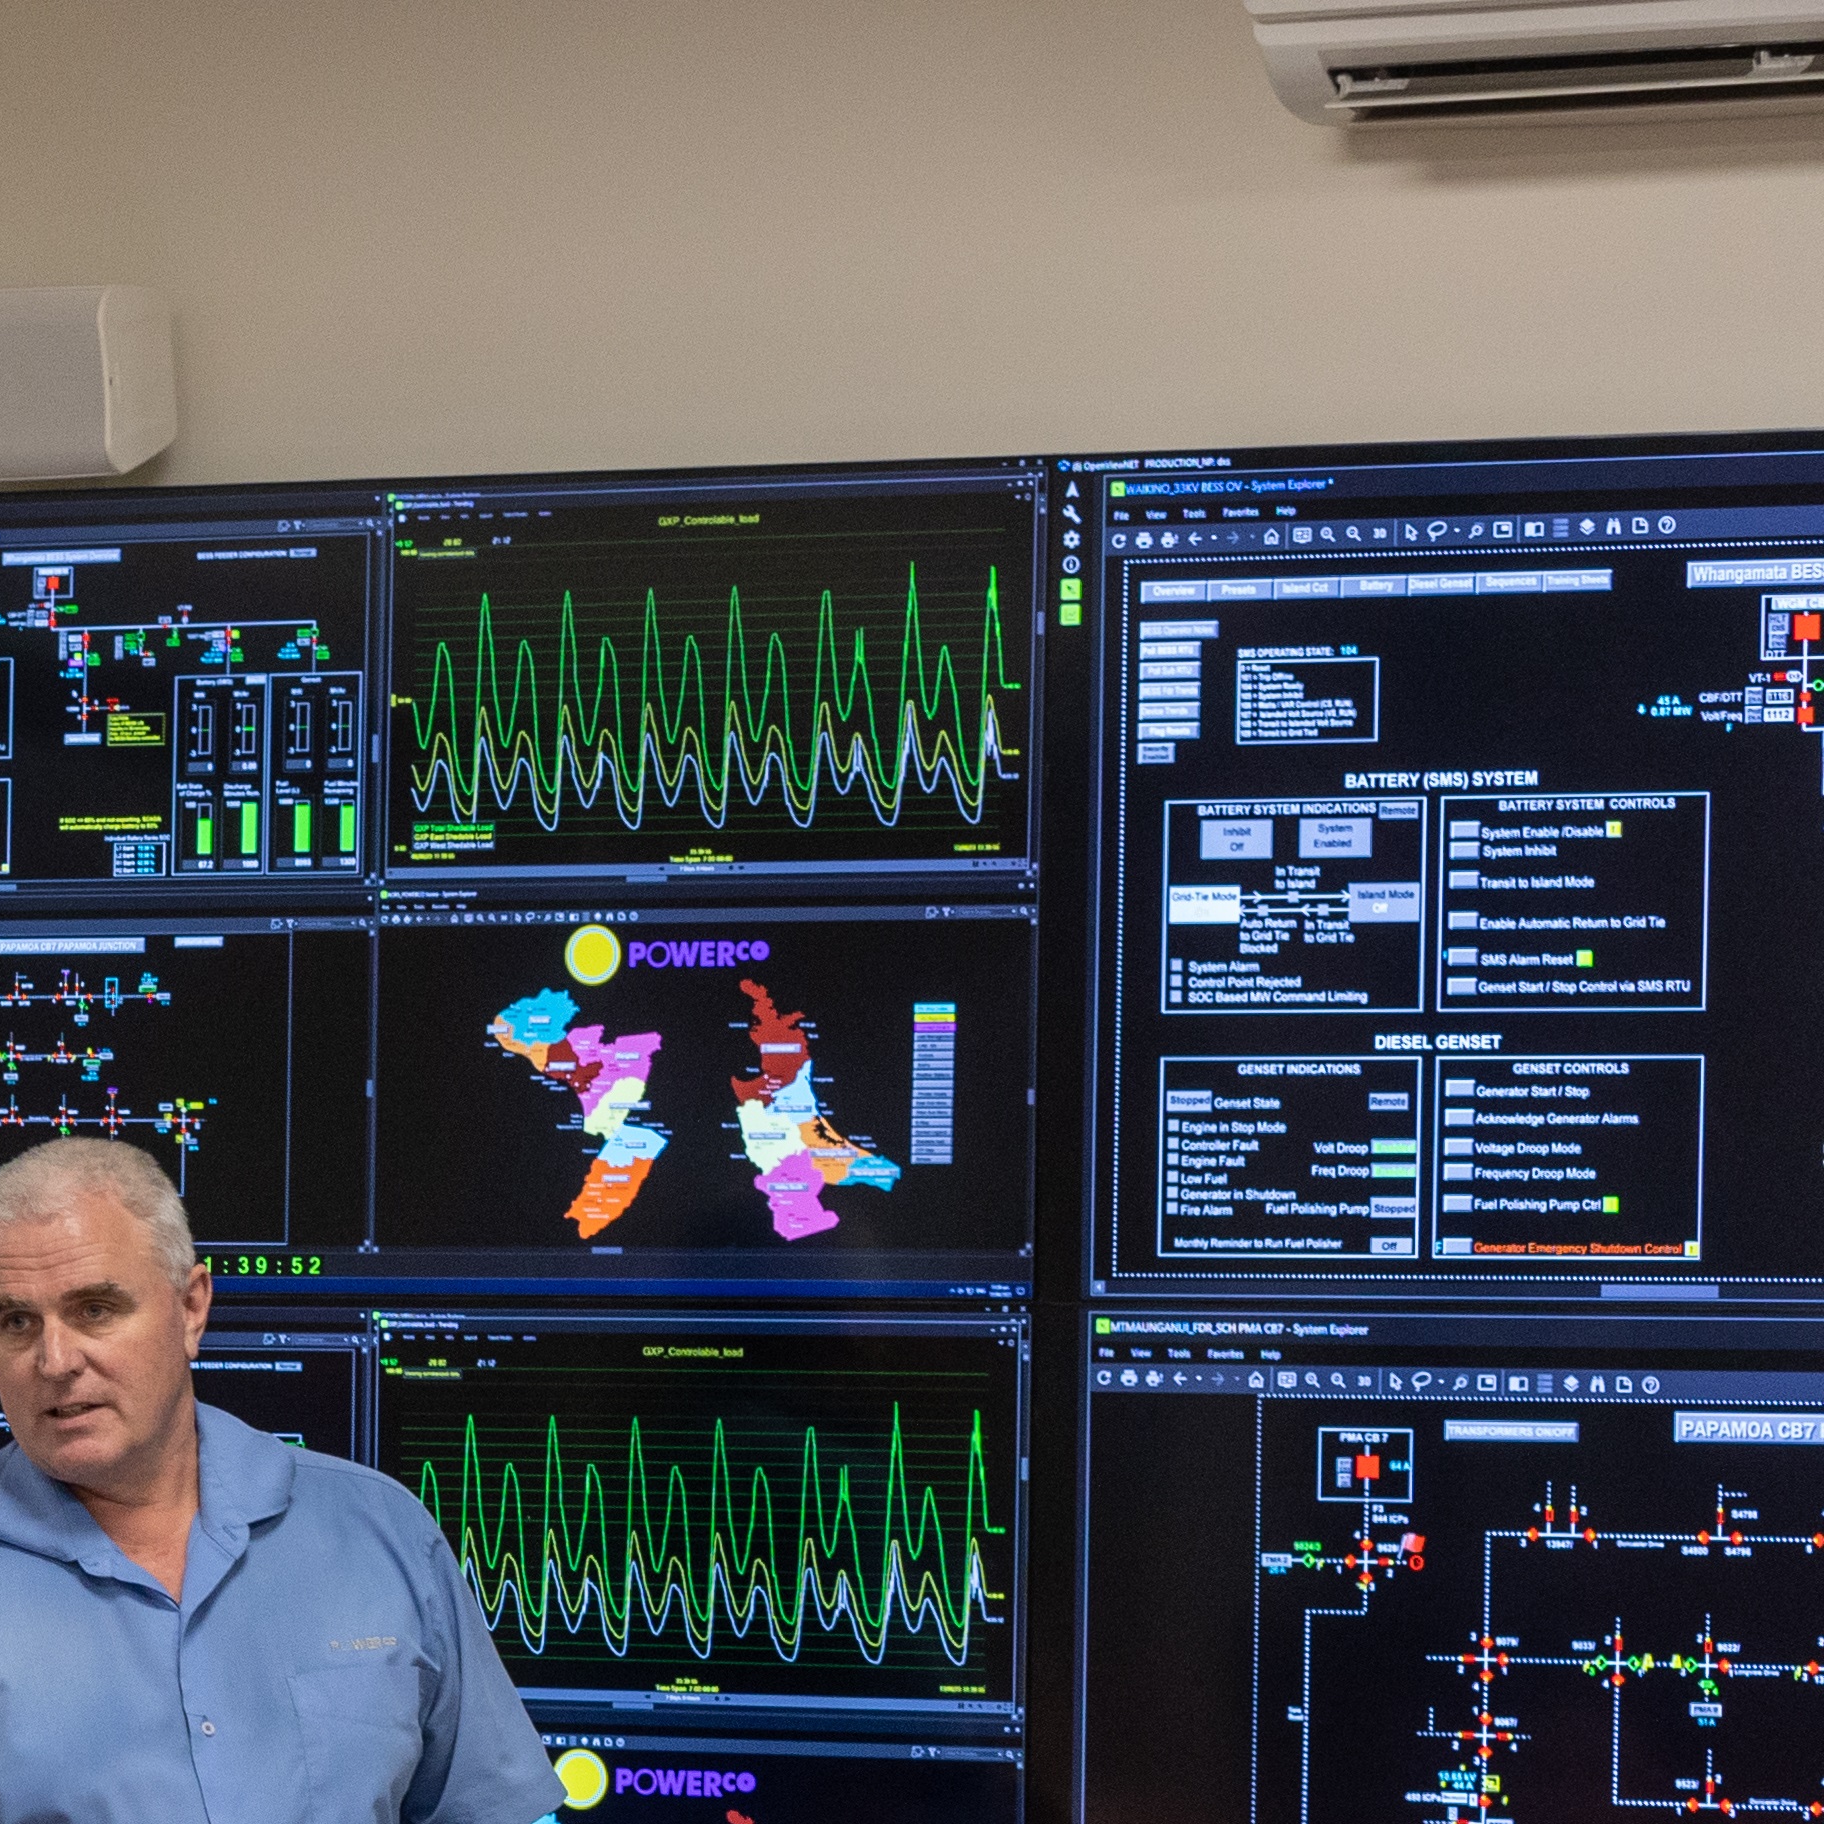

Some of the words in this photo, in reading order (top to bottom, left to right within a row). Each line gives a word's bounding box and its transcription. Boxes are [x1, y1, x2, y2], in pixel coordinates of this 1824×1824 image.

[1251, 480, 1285, 493] System
[1288, 479, 1326, 491] Explorer
[240, 550, 287, 559] CONFIGURATION
[1548, 575, 1580, 587] Training
[1581, 574, 1609, 585] Sheets
[1693, 566, 1787, 584] Whangamata
[1282, 582, 1308, 594] Island
[1360, 580, 1393, 593] Battery
[1409, 578, 1438, 589] Diesel
[1440, 577, 1473, 589] Genset
[1485, 576, 1537, 588] Sequences
[1153, 585, 1195, 597] Overview
[1222, 584, 1256, 595] Presets
[1344, 773, 1420, 789] BATTERY
[1423, 772, 1469, 789] (SMS)
[1472, 771, 1539, 786] SYSTEM
[1198, 805, 1251, 816] BATTERY
[1253, 804, 1301, 815] SYSTEM
[1303, 803, 1377, 814] INDICATIONS
[1381, 806, 1416, 815] Remote
[1498, 799, 1553, 811] BATTERY
[1556, 798, 1604, 810] SYSTEM
[1609, 797, 1676, 809] CONTROLS
[1223, 827, 1252, 836] Inhibit
[1318, 824, 1353, 835] System
[1482, 827, 1520, 839] System
[1522, 827, 1559, 838] Enable
[1314, 839, 1352, 848] Enabled
[1480, 877, 1516, 889] Transit
[1518, 878, 1529, 888] to
[1531, 877, 1562, 888] Island
[1565, 877, 1595, 888] Mode
[1172, 892, 1209, 901] Grid-Tie
[1212, 892, 1237, 901] Mode
[1358, 890, 1385, 899] Island
[1388, 890, 1415, 899] Mode
[1480, 918, 1516, 929] Enable
[1518, 918, 1571, 929] Automatic
[1573, 917, 1608, 929] Return
[1610, 917, 1621, 928] to
[1623, 917, 1646, 928] Grid
[1649, 917, 1666, 928] Tie
[1, 942, 39, 951] PAPAMOA
[40, 942, 56, 951] CB7
[58, 942, 96, 950] PAPAMOA
[98, 941, 136, 950] JUNCTION
[629, 941, 770, 968] POWERCO
[1480, 955, 1508, 966] SMS
[1510, 955, 1541, 966] Alarm
[1542, 954, 1574, 966] Reset
[1188, 961, 1227, 974] System
[1229, 961, 1260, 972] Alarm
[1188, 977, 1226, 988] Control
[1228, 976, 1254, 988] Point
[1256, 976, 1302, 989] Rejected
[1479, 981, 1517, 992] Genset
[1519, 981, 1544, 992] Start
[1552, 981, 1577, 995] Stop
[1579, 981, 1617, 992] Control
[1619, 982, 1635, 992] via
[1637, 980, 1663, 992] SMS
[1665, 980, 1691, 991] RTU
[1188, 991, 1214, 1003] SOC
[1215, 991, 1249, 1003] Based
[1251, 991, 1271, 1003] MW
[1272, 991, 1326, 1002] Command
[1328, 990, 1368, 1004] Limiting
[1374, 1035, 1432, 1050] DIESEL
[1436, 1034, 1502, 1050] GENSET
[1237, 1064, 1284, 1075] GENSET
[1286, 1064, 1361, 1075] INDICATIONS
[1513, 1063, 1561, 1074] GENSET
[1563, 1063, 1629, 1074] CONTROLS
[1475, 1114, 1545, 1127] Acknowledge
[1546, 1114, 1600, 1125] Generator
[1602, 1114, 1639, 1125] Alarms
[1182, 1122, 1217, 1135] Engine
[1219, 1122, 1229, 1133] in
[1231, 1122, 1255, 1134] Stop
[1257, 1122, 1287, 1133] Mode
[1475, 1143, 1515, 1155] Voltage
[1517, 1143, 1549, 1156] Droop
[1551, 1143, 1582, 1154] Mode
[1181, 1155, 1217, 1168] Engine
[1219, 1155, 1246, 1167] Fault
[1475, 1168, 1530, 1181] Frequency
[1532, 1168, 1564, 1181] Droop
[1566, 1168, 1597, 1180] Mode
[1265, 1203, 1289, 1215] Fuel
[1290, 1203, 1337, 1217] Polishing
[1339, 1203, 1369, 1217] Pump
[1474, 1199, 1498, 1211] Fuel
[1500, 1199, 1547, 1213] Polishing
[1549, 1199, 1580, 1213] Pump
[1582, 1199, 1601, 1211] Ctrl
[1474, 1242, 1526, 1254] Generator
[1528, 1243, 1587, 1256] Emergency
[1590, 1242, 1641, 1254] Shutdown
[1644, 1242, 1683, 1254] Control
[1238, 1322, 1262, 1334] PMA
[1264, 1322, 1284, 1334] CB7
[1293, 1324, 1328, 1337] System
[1330, 1324, 1369, 1337] Explorer
[1448, 1425, 1533, 1437] TRANSFORMERS
[1535, 1426, 1576, 1438] ON/OFF
[1681, 1420, 1773, 1439] PAPAMOA
[1777, 1422, 1814, 1440] CB7
[1339, 1432, 1364, 1443] PMA
[1365, 1432, 1380, 1443] CB
[615, 1768, 757, 1798] POWERCO
